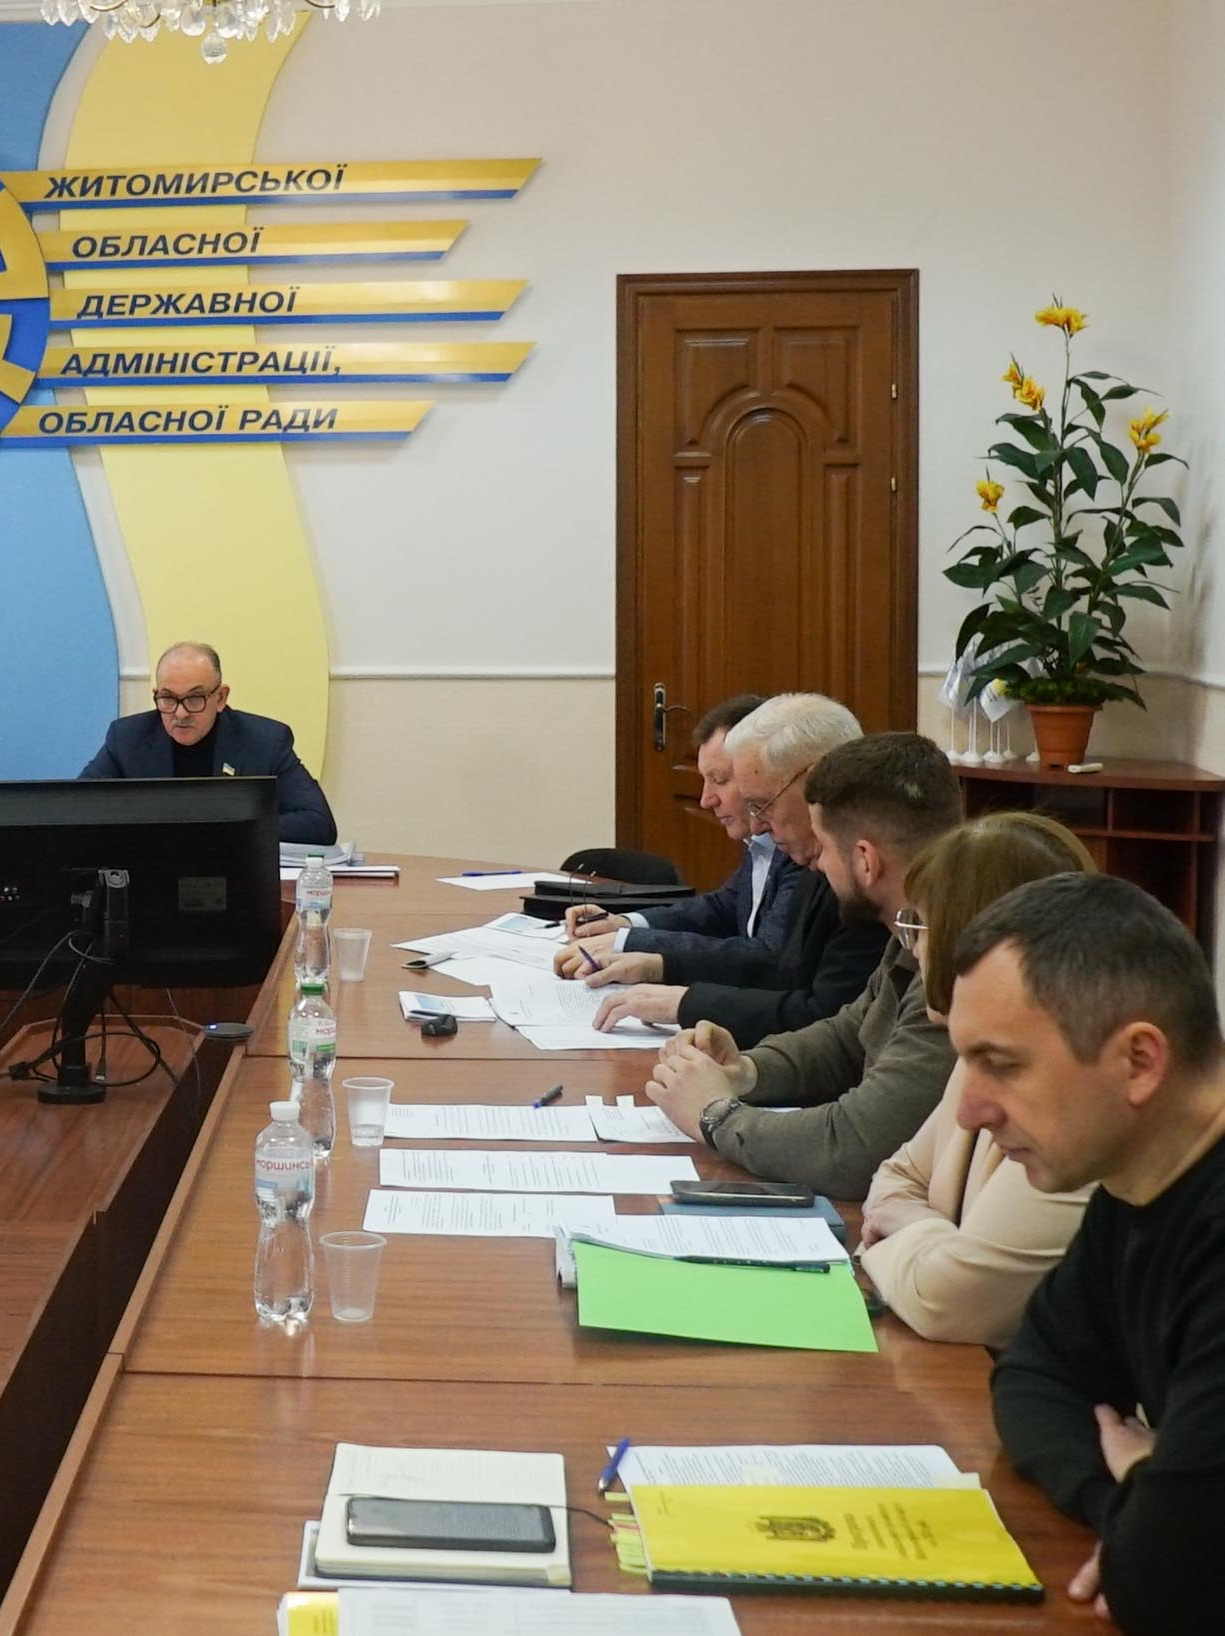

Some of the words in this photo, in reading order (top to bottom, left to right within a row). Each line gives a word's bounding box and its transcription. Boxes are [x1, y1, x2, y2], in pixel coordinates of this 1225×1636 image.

[43, 164, 348, 199] ЖИТОМИРСЬКОЇ
[72, 227, 264, 258] ОБЛАСНОЇ
[76, 286, 300, 320] ДЕРЖАВНОЇ
[60, 345, 342, 376] АДМІНІСТРАЦІЇ,
[38, 405, 231, 434] ОБЛАСНОЇ
[238, 408, 338, 432] РАДИ
